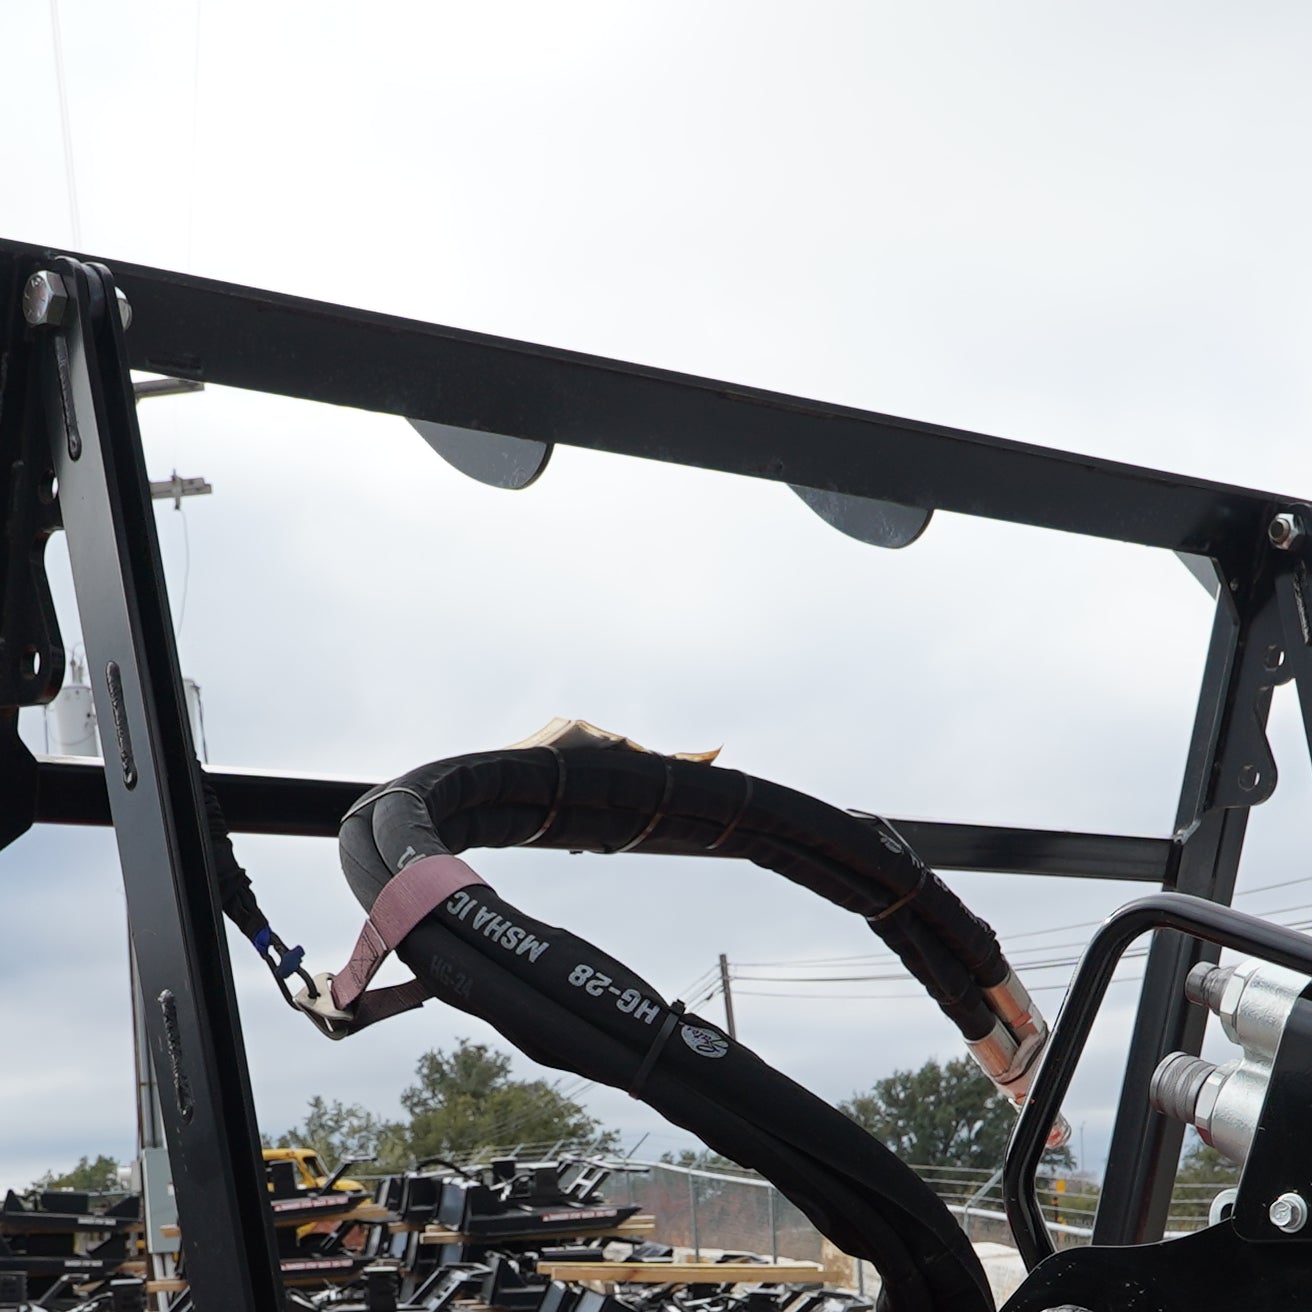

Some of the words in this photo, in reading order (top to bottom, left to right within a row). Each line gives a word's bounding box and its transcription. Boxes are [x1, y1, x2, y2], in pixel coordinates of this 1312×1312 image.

[446, 891, 478, 919] IC
[472, 908, 550, 964] MSHA
[568, 963, 660, 1024] HG-28
